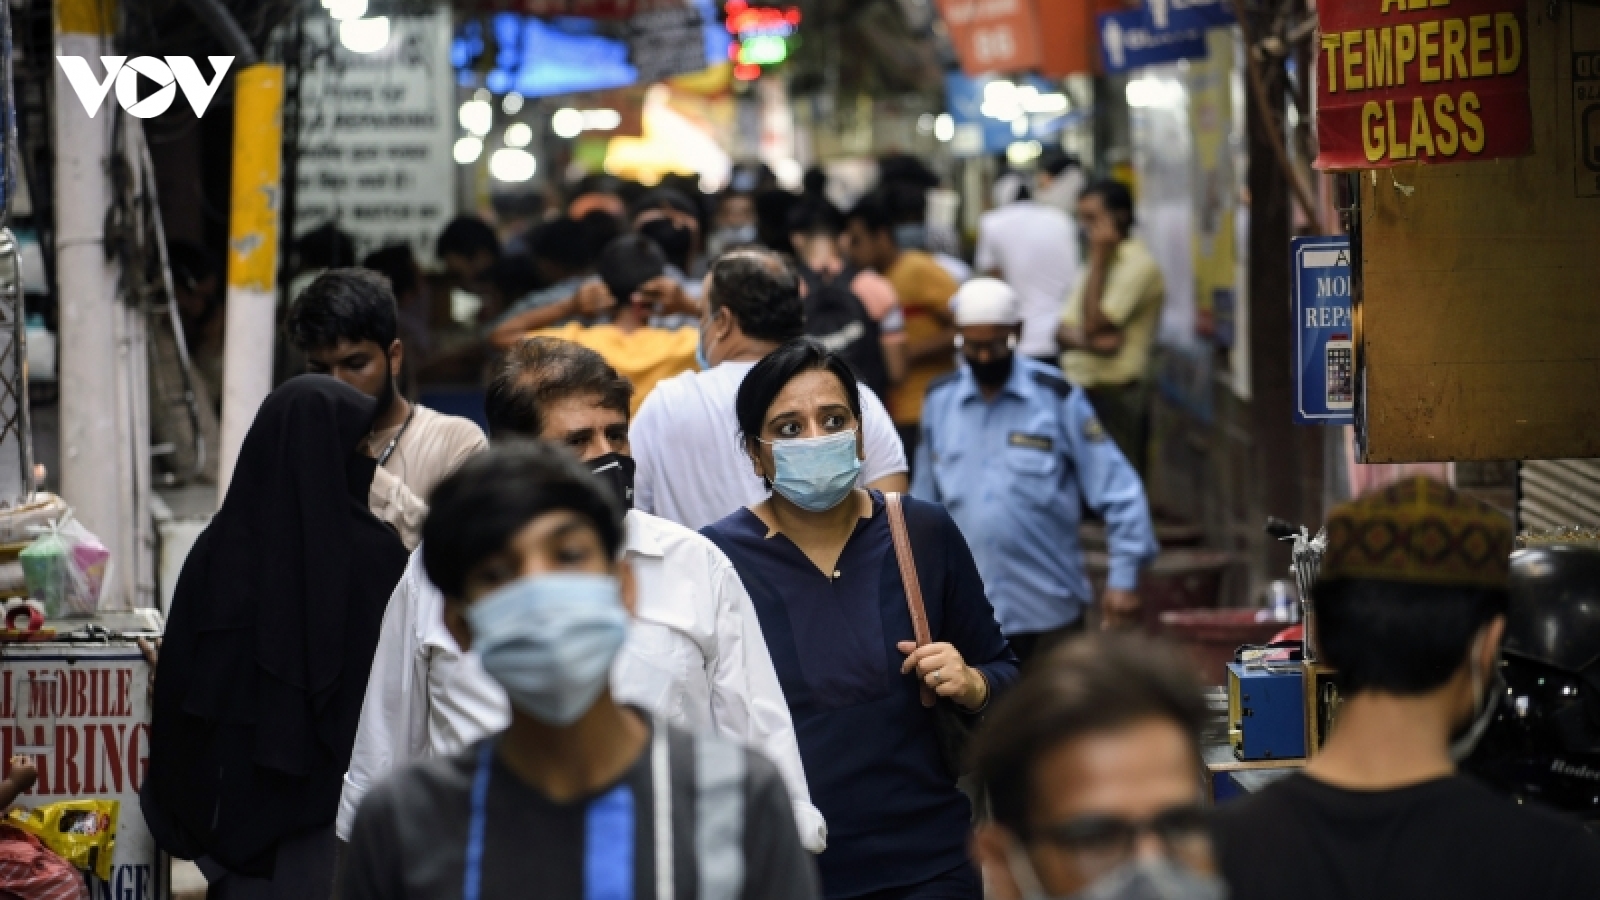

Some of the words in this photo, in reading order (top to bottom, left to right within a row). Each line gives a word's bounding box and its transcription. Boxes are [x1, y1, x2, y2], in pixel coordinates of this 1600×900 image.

[1320, 12, 1521, 93] TEMPERED
[1362, 91, 1485, 161] GLASS
[28, 669, 132, 719] MOBILE
